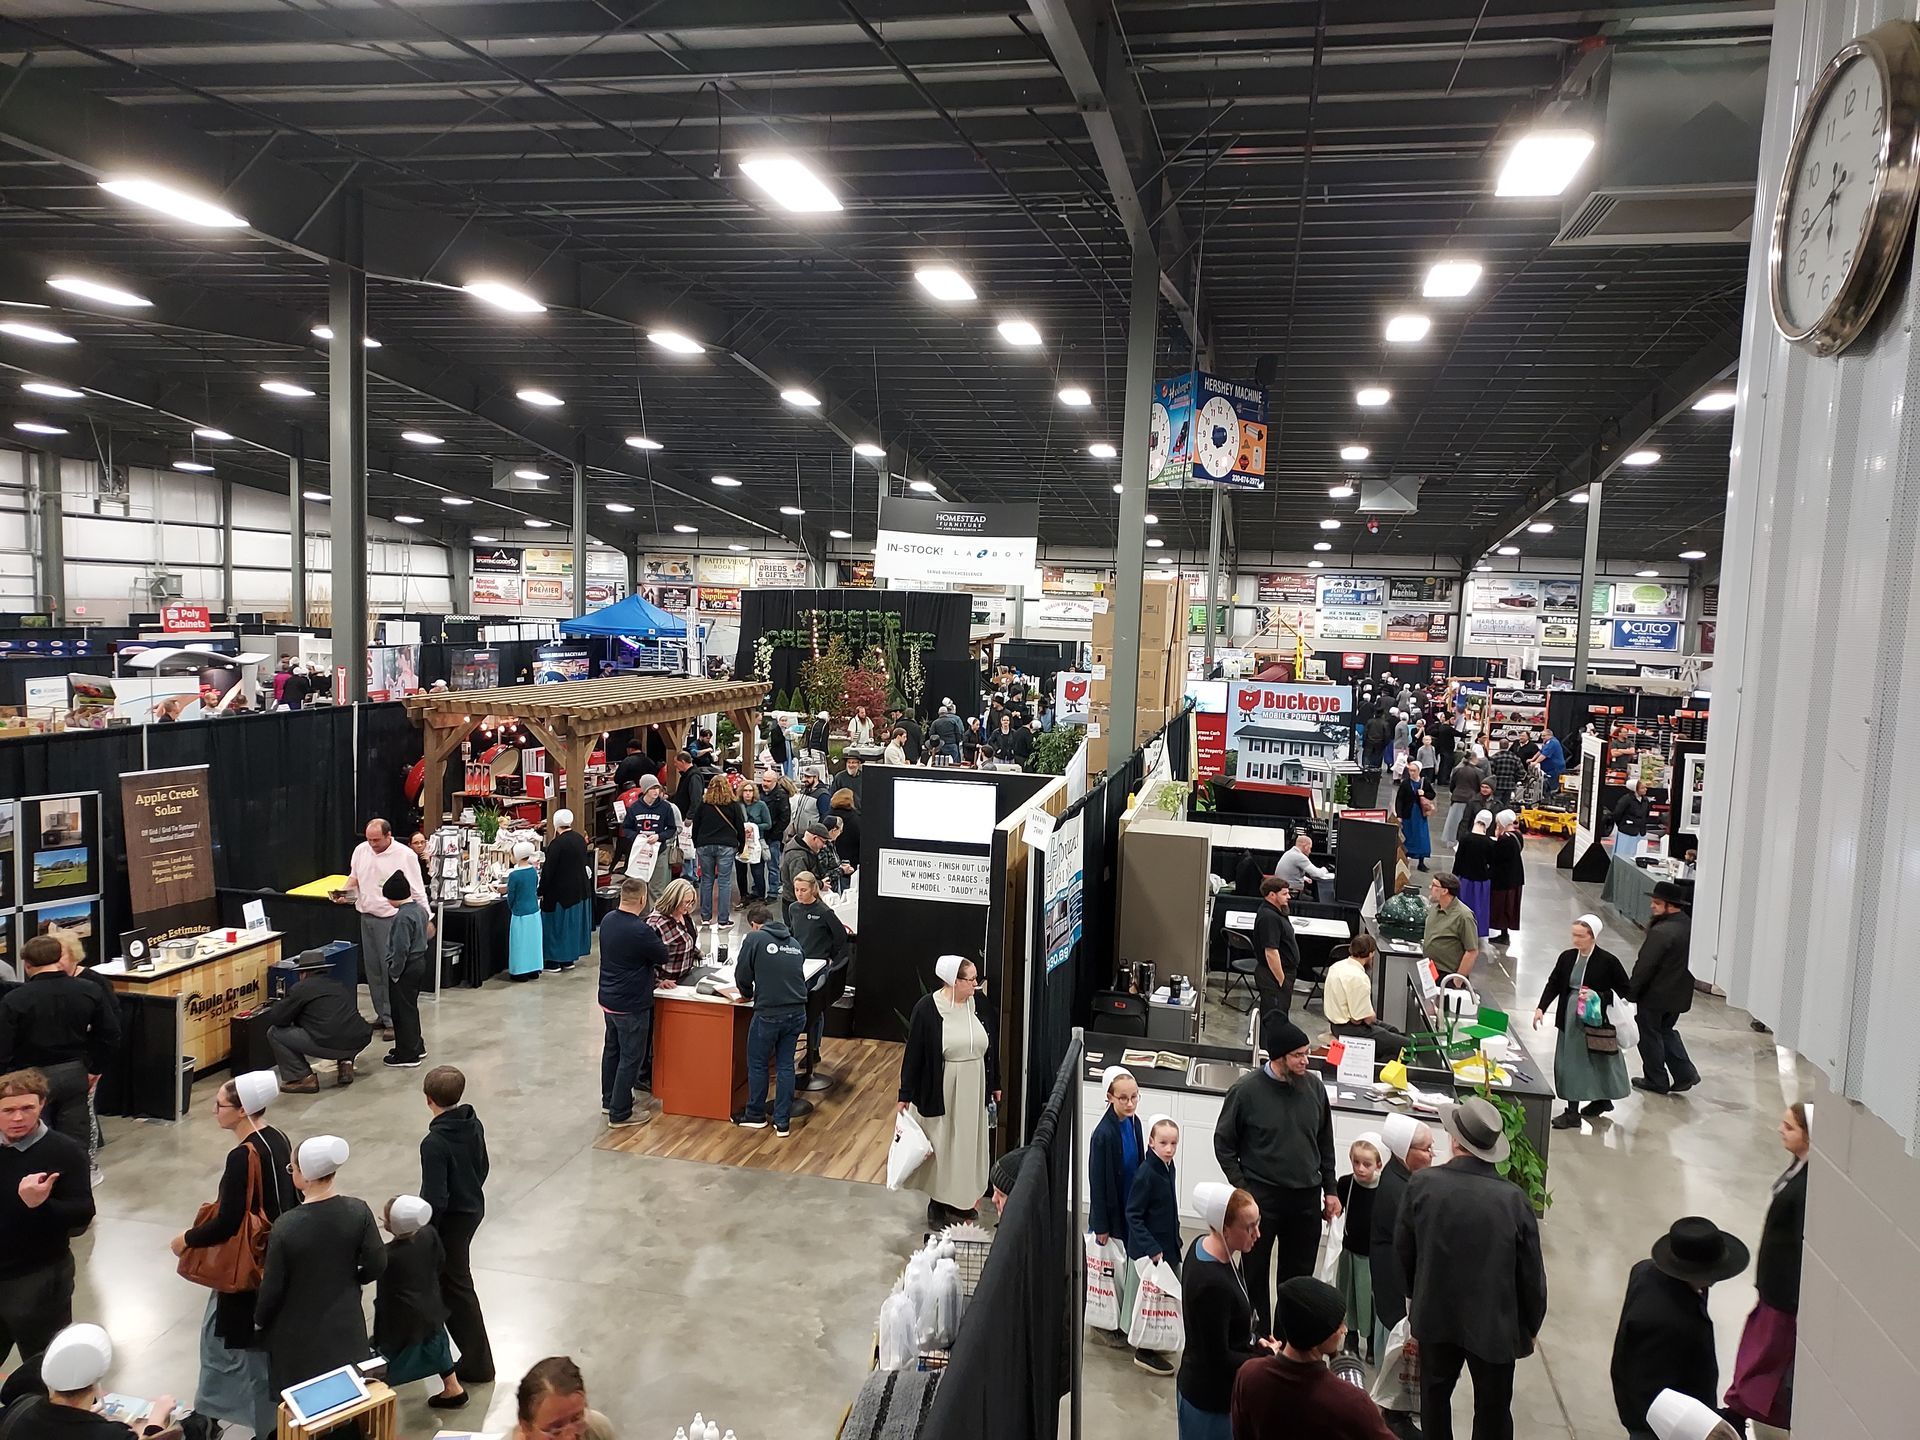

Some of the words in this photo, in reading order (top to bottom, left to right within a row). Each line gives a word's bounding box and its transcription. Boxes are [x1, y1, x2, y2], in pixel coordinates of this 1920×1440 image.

[1843, 88, 1857, 120] 12
[1871, 105, 1883, 137] 2
[1825, 118, 1837, 147] 11
[1808, 161, 1821, 190] 10
[1800, 207, 1811, 233] 9
[1797, 249, 1808, 275] 8
[1841, 249, 1851, 278] 5
[1807, 271, 1816, 298] 7
[1821, 274, 1831, 300] 6
[1204, 377, 1233, 396] HERSHEY
[1235, 386, 1262, 404] MACHINE
[1218, 406, 1222, 414] 12
[936, 514, 986, 523] HOMESTEAD
[887, 543, 944, 555] IN-STOCK!
[701, 592, 729, 600] Supplies
[1392, 590, 1418, 598] Machine
[182, 609, 200, 620] Poly
[168, 619, 206, 629] Cabinets
[1632, 622, 1671, 633] CUTCO
[1264, 690, 1341, 713] Buckeye
[1262, 711, 1288, 720] MOBILE
[1291, 713, 1316, 721] POWER
[1319, 714, 1340, 722] WASH
[135, 792, 167, 806] Apple
[168, 787, 199, 800] Creek
[154, 804, 182, 816] Solar
[643, 820, 651, 830] C
[888, 858, 931, 868] RENOVATIONS
[939, 862, 959, 870] FINISH
[918, 872, 940, 880] HOMES
[948, 874, 978, 883] GARAGES
[911, 882, 940, 892] REMODEL
[147, 932, 167, 947] Free
[168, 924, 211, 938] Estimates
[190, 993, 224, 1016] Apple
[225, 979, 260, 1000] Creek
[210, 1000, 239, 1018] SOLAR
[1142, 1308, 1178, 1318] BERNINA
